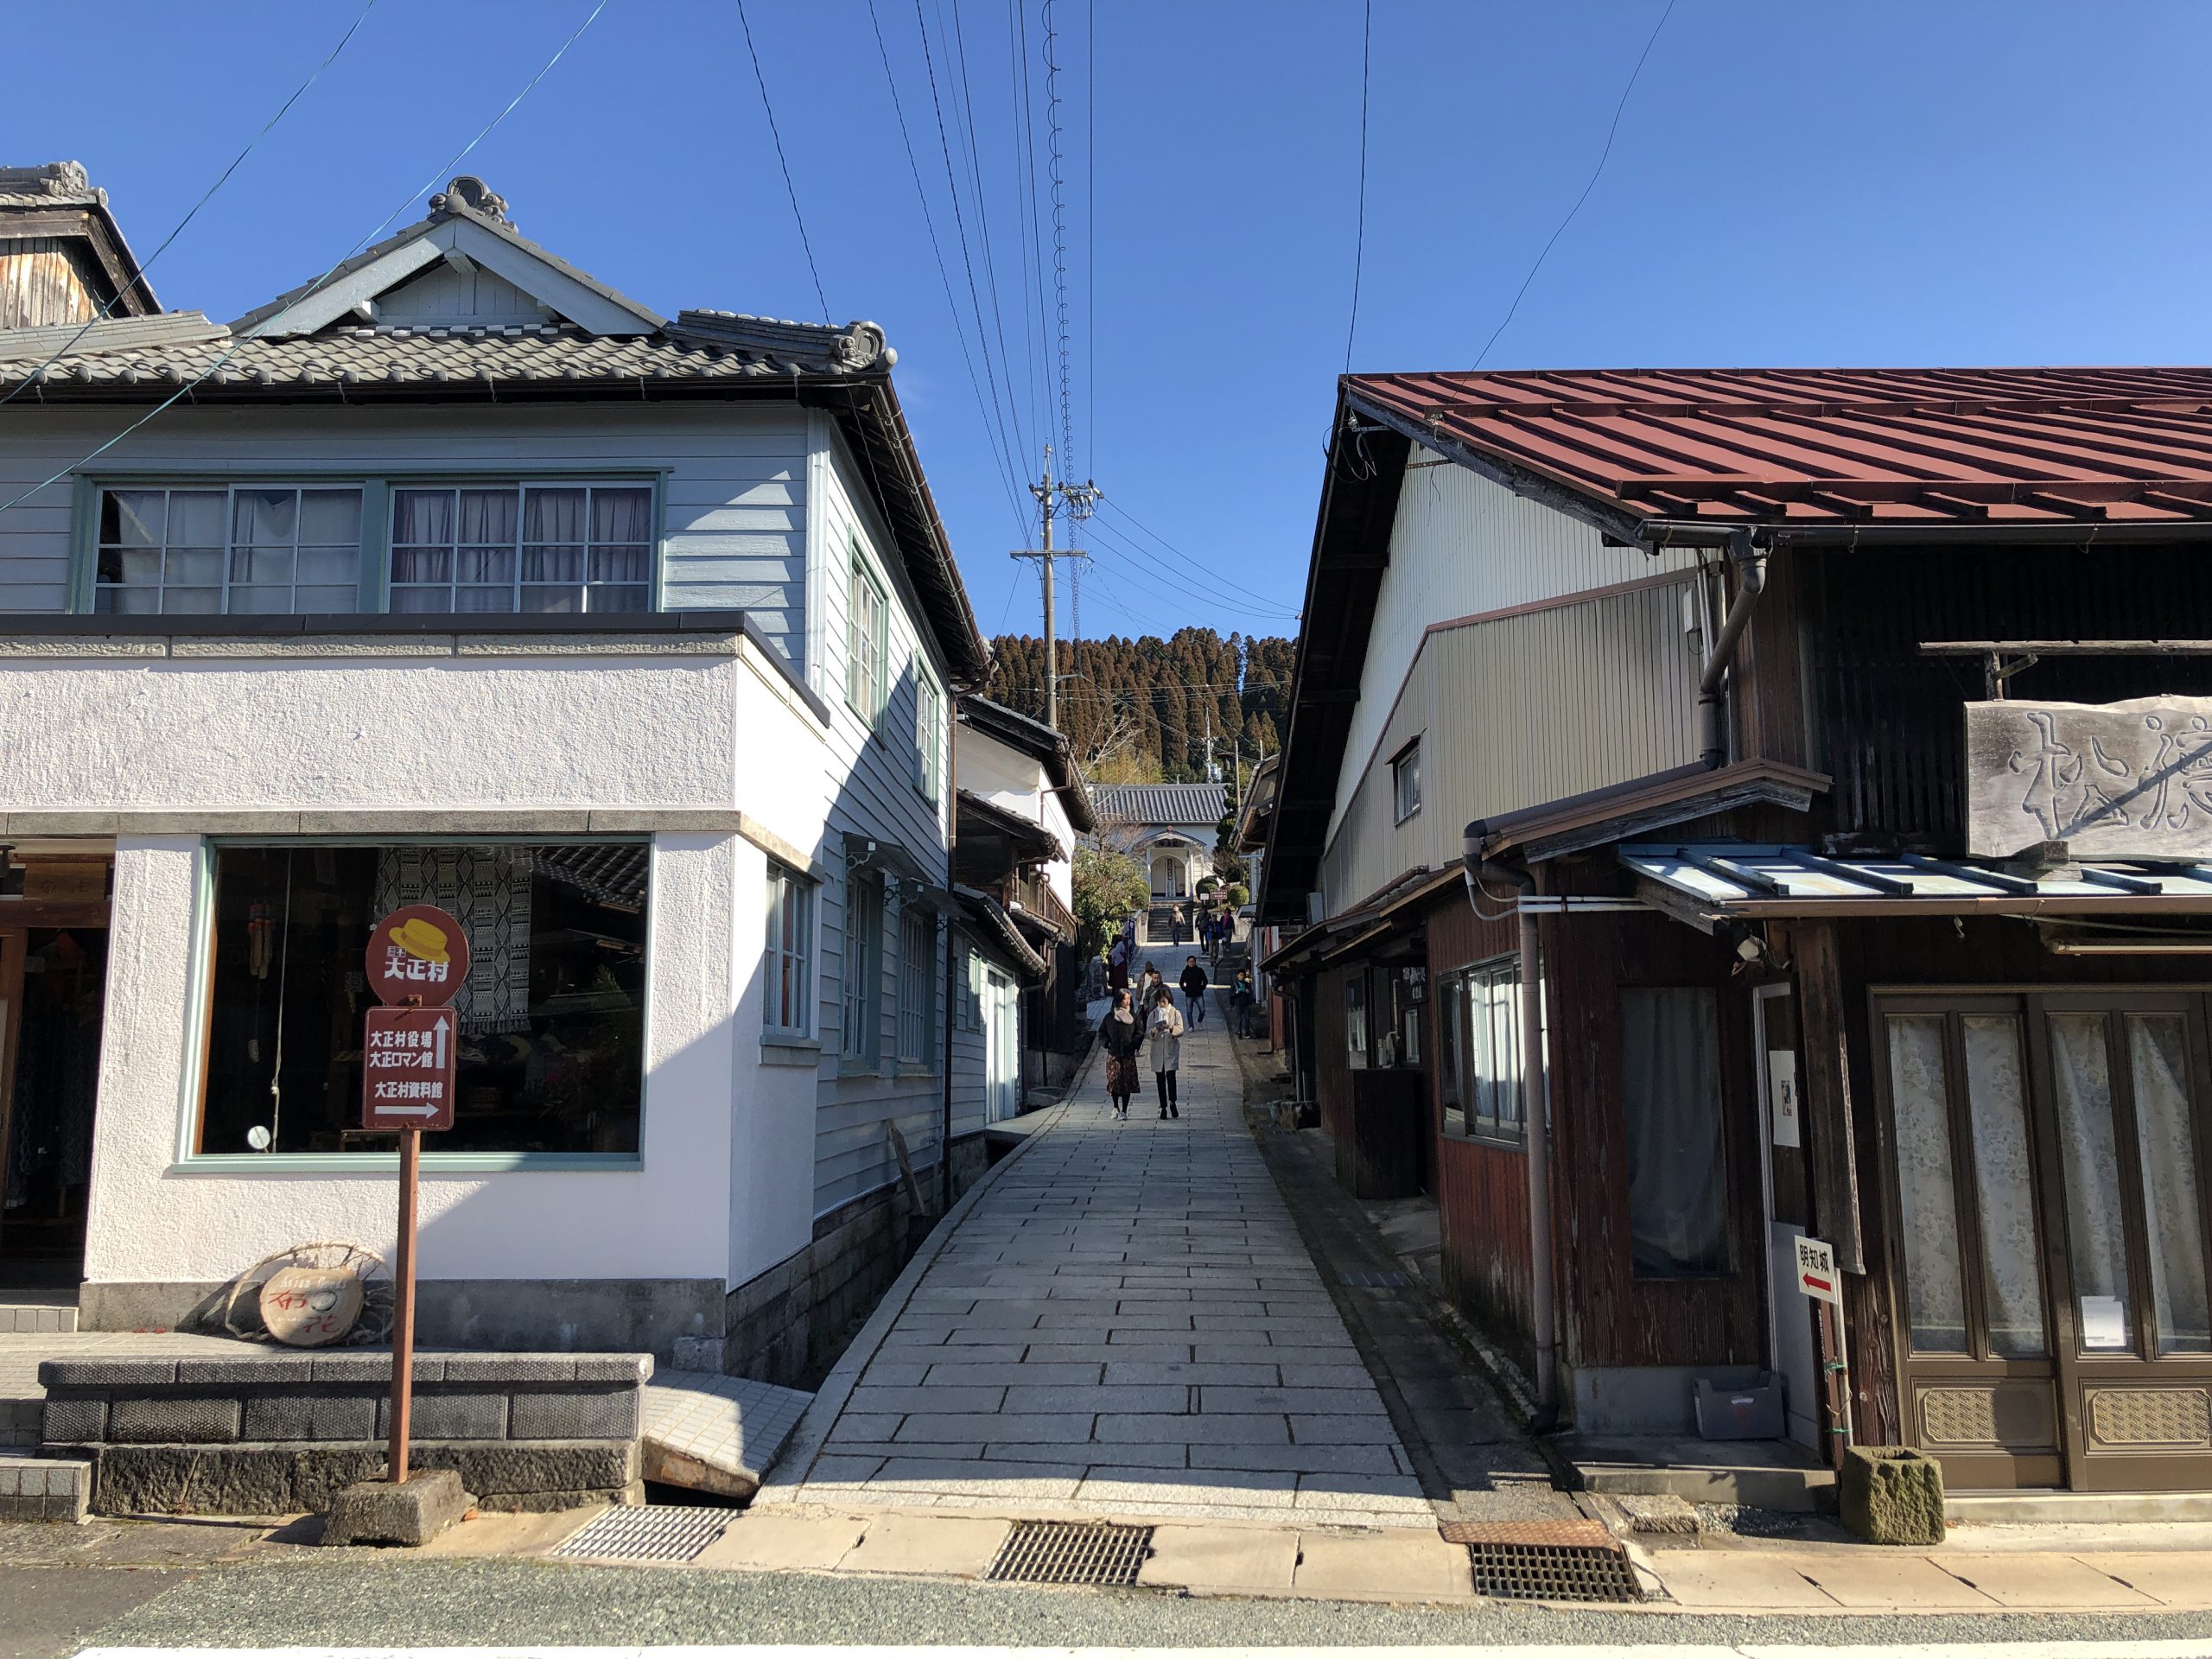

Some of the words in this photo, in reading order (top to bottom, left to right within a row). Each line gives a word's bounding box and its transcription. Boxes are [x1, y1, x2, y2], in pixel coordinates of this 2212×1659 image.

[385, 957, 449, 982] 大正村
[370, 1030, 433, 1048] 大正村役場
[369, 1051, 434, 1069] 大正ロマン館
[374, 1081, 443, 1099] 大正村資料館
[1799, 1243, 1830, 1274] 明知城
[280, 1277, 311, 1288] Asian
